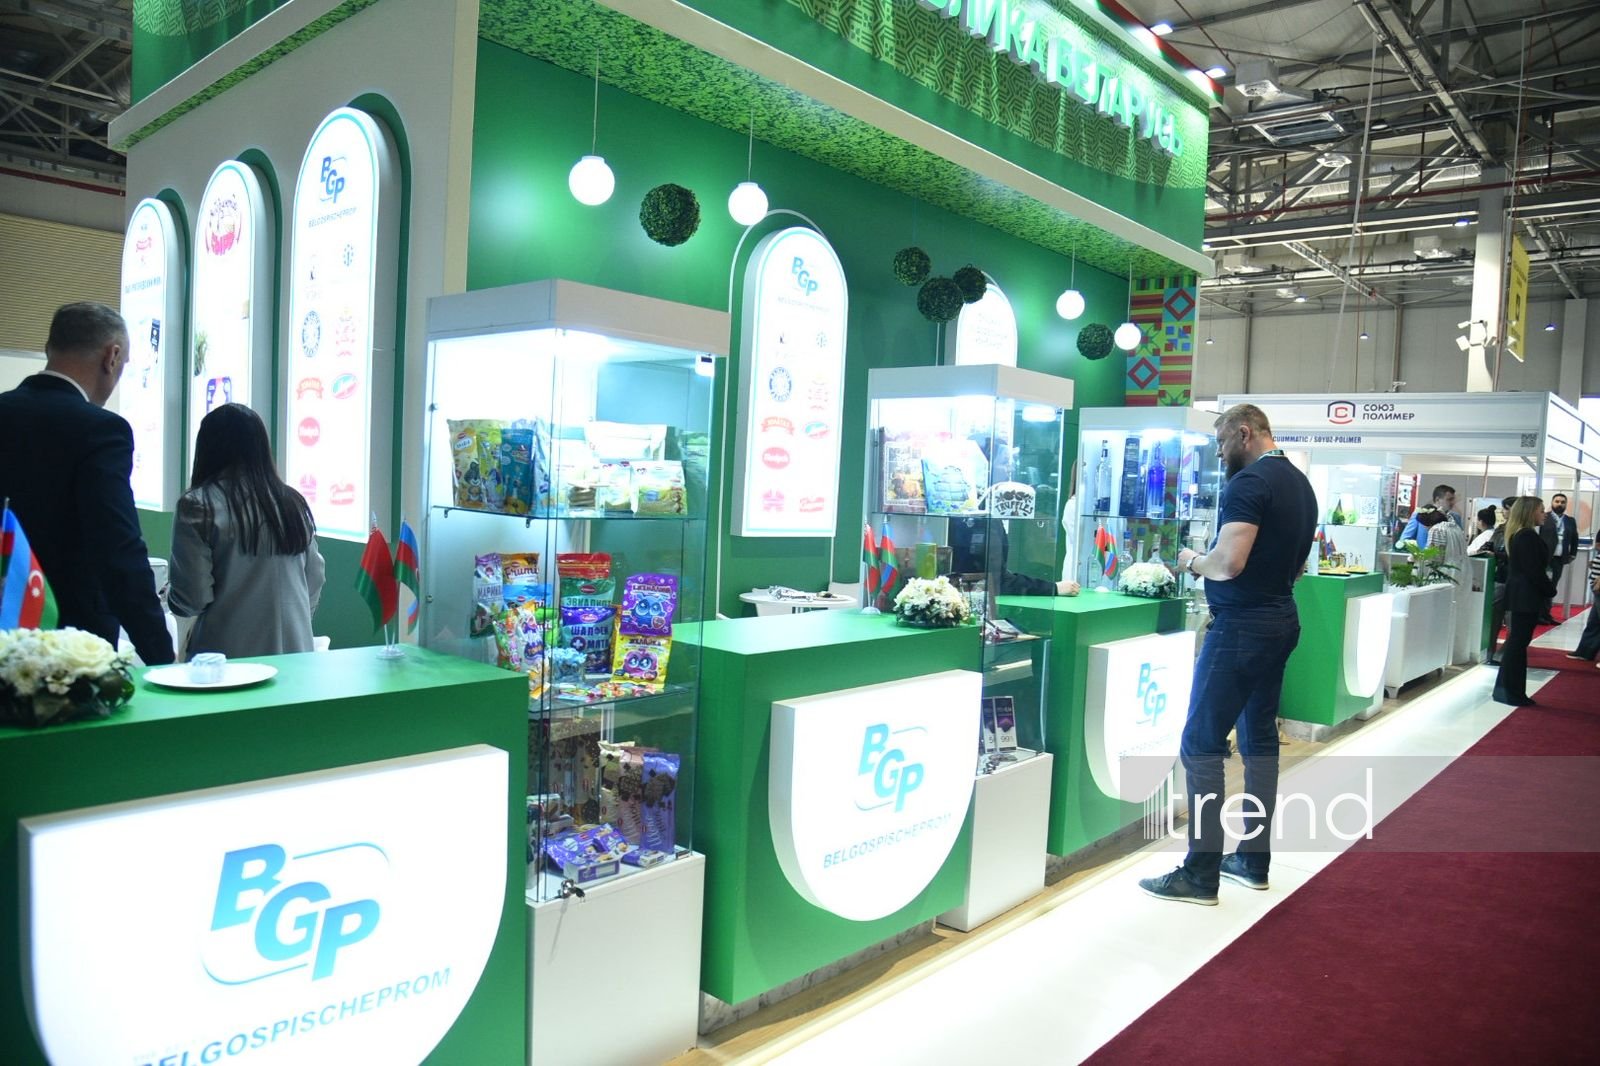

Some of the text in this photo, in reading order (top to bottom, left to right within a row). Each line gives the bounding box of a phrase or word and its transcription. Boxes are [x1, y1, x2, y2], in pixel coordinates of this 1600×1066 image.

[1046, 37, 1184, 157] БЕЛАРУСЬ
[320, 156, 345, 203] BGP
[791, 256, 818, 296] BGP
[1362, 412, 1415, 421] ПОЛИМЕР
[1363, 403, 1395, 412] СОЮЗ
[1272, 435, 1308, 443] CUUMMATIC
[1313, 435, 1362, 444] SOYUZ-POLIMER
[995, 500, 1034, 515] TRUFFLES
[1136, 662, 1167, 727] BGP
[858, 723, 925, 813] BGP
[211, 843, 381, 982] BGP
[141, 967, 451, 1066] LGOSPISCHEPROM
